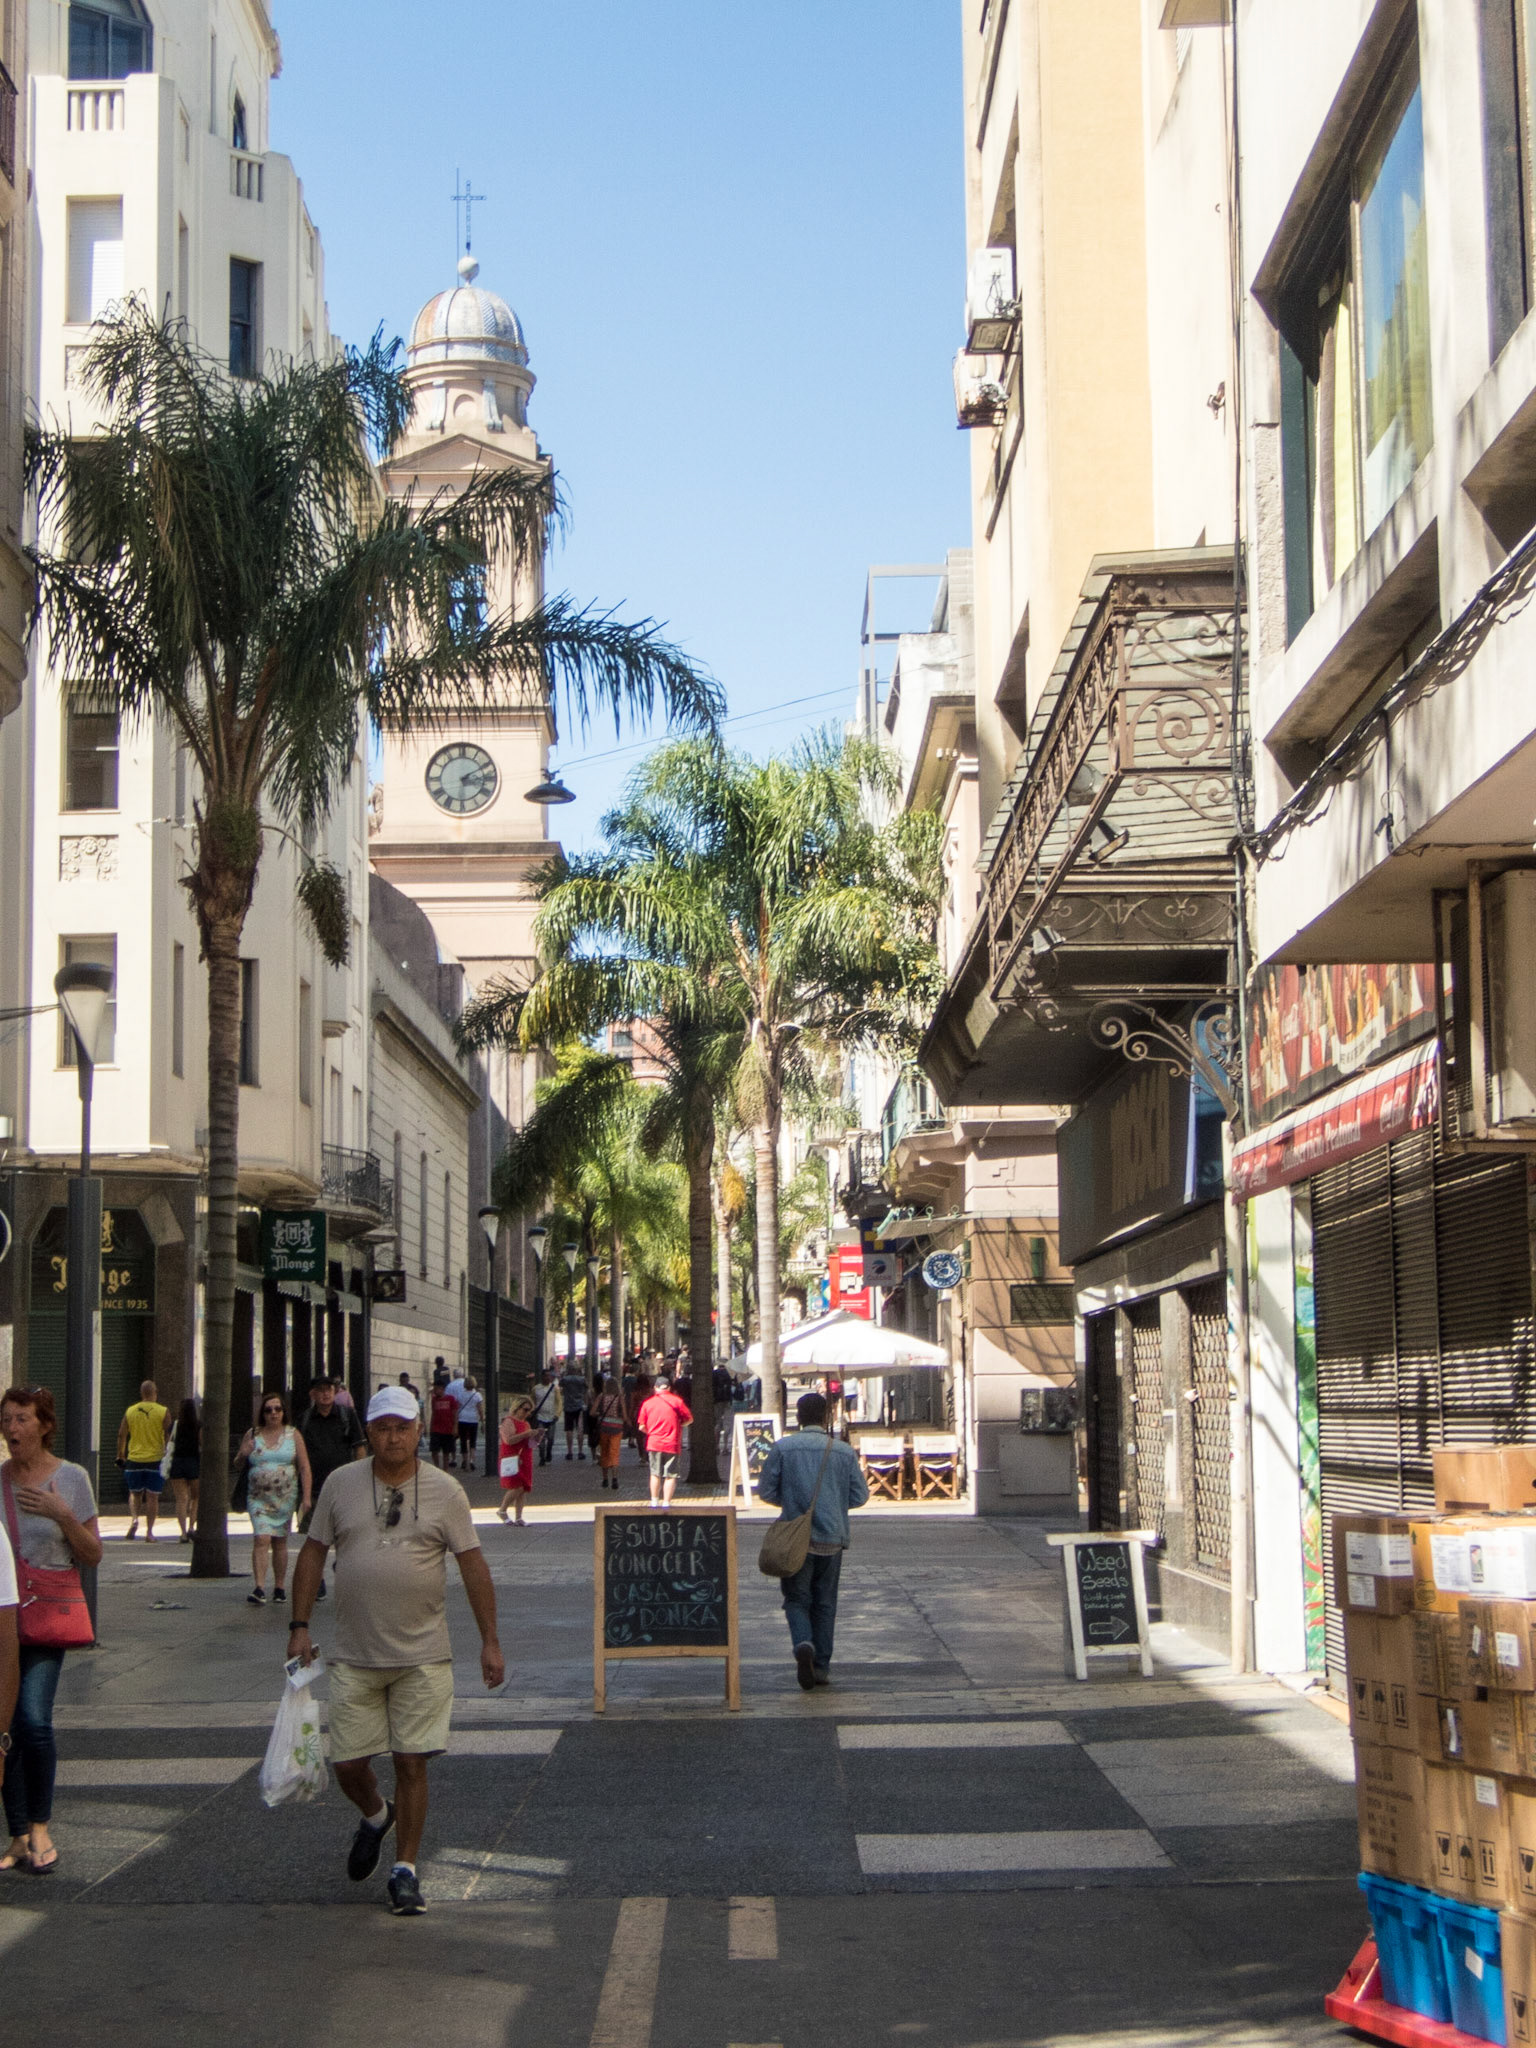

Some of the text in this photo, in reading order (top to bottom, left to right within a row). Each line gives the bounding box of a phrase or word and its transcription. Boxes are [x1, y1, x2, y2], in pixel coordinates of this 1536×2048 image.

[270, 1254, 316, 1273] Monge
[127, 1300, 148, 1309] 1935
[626, 1520, 708, 1549] SUBÍ A
[608, 1551, 705, 1576] CONOCER
[1077, 1545, 1128, 1571] Weed
[1081, 1570, 1129, 1590] Seeds
[613, 1582, 670, 1602] CASA
